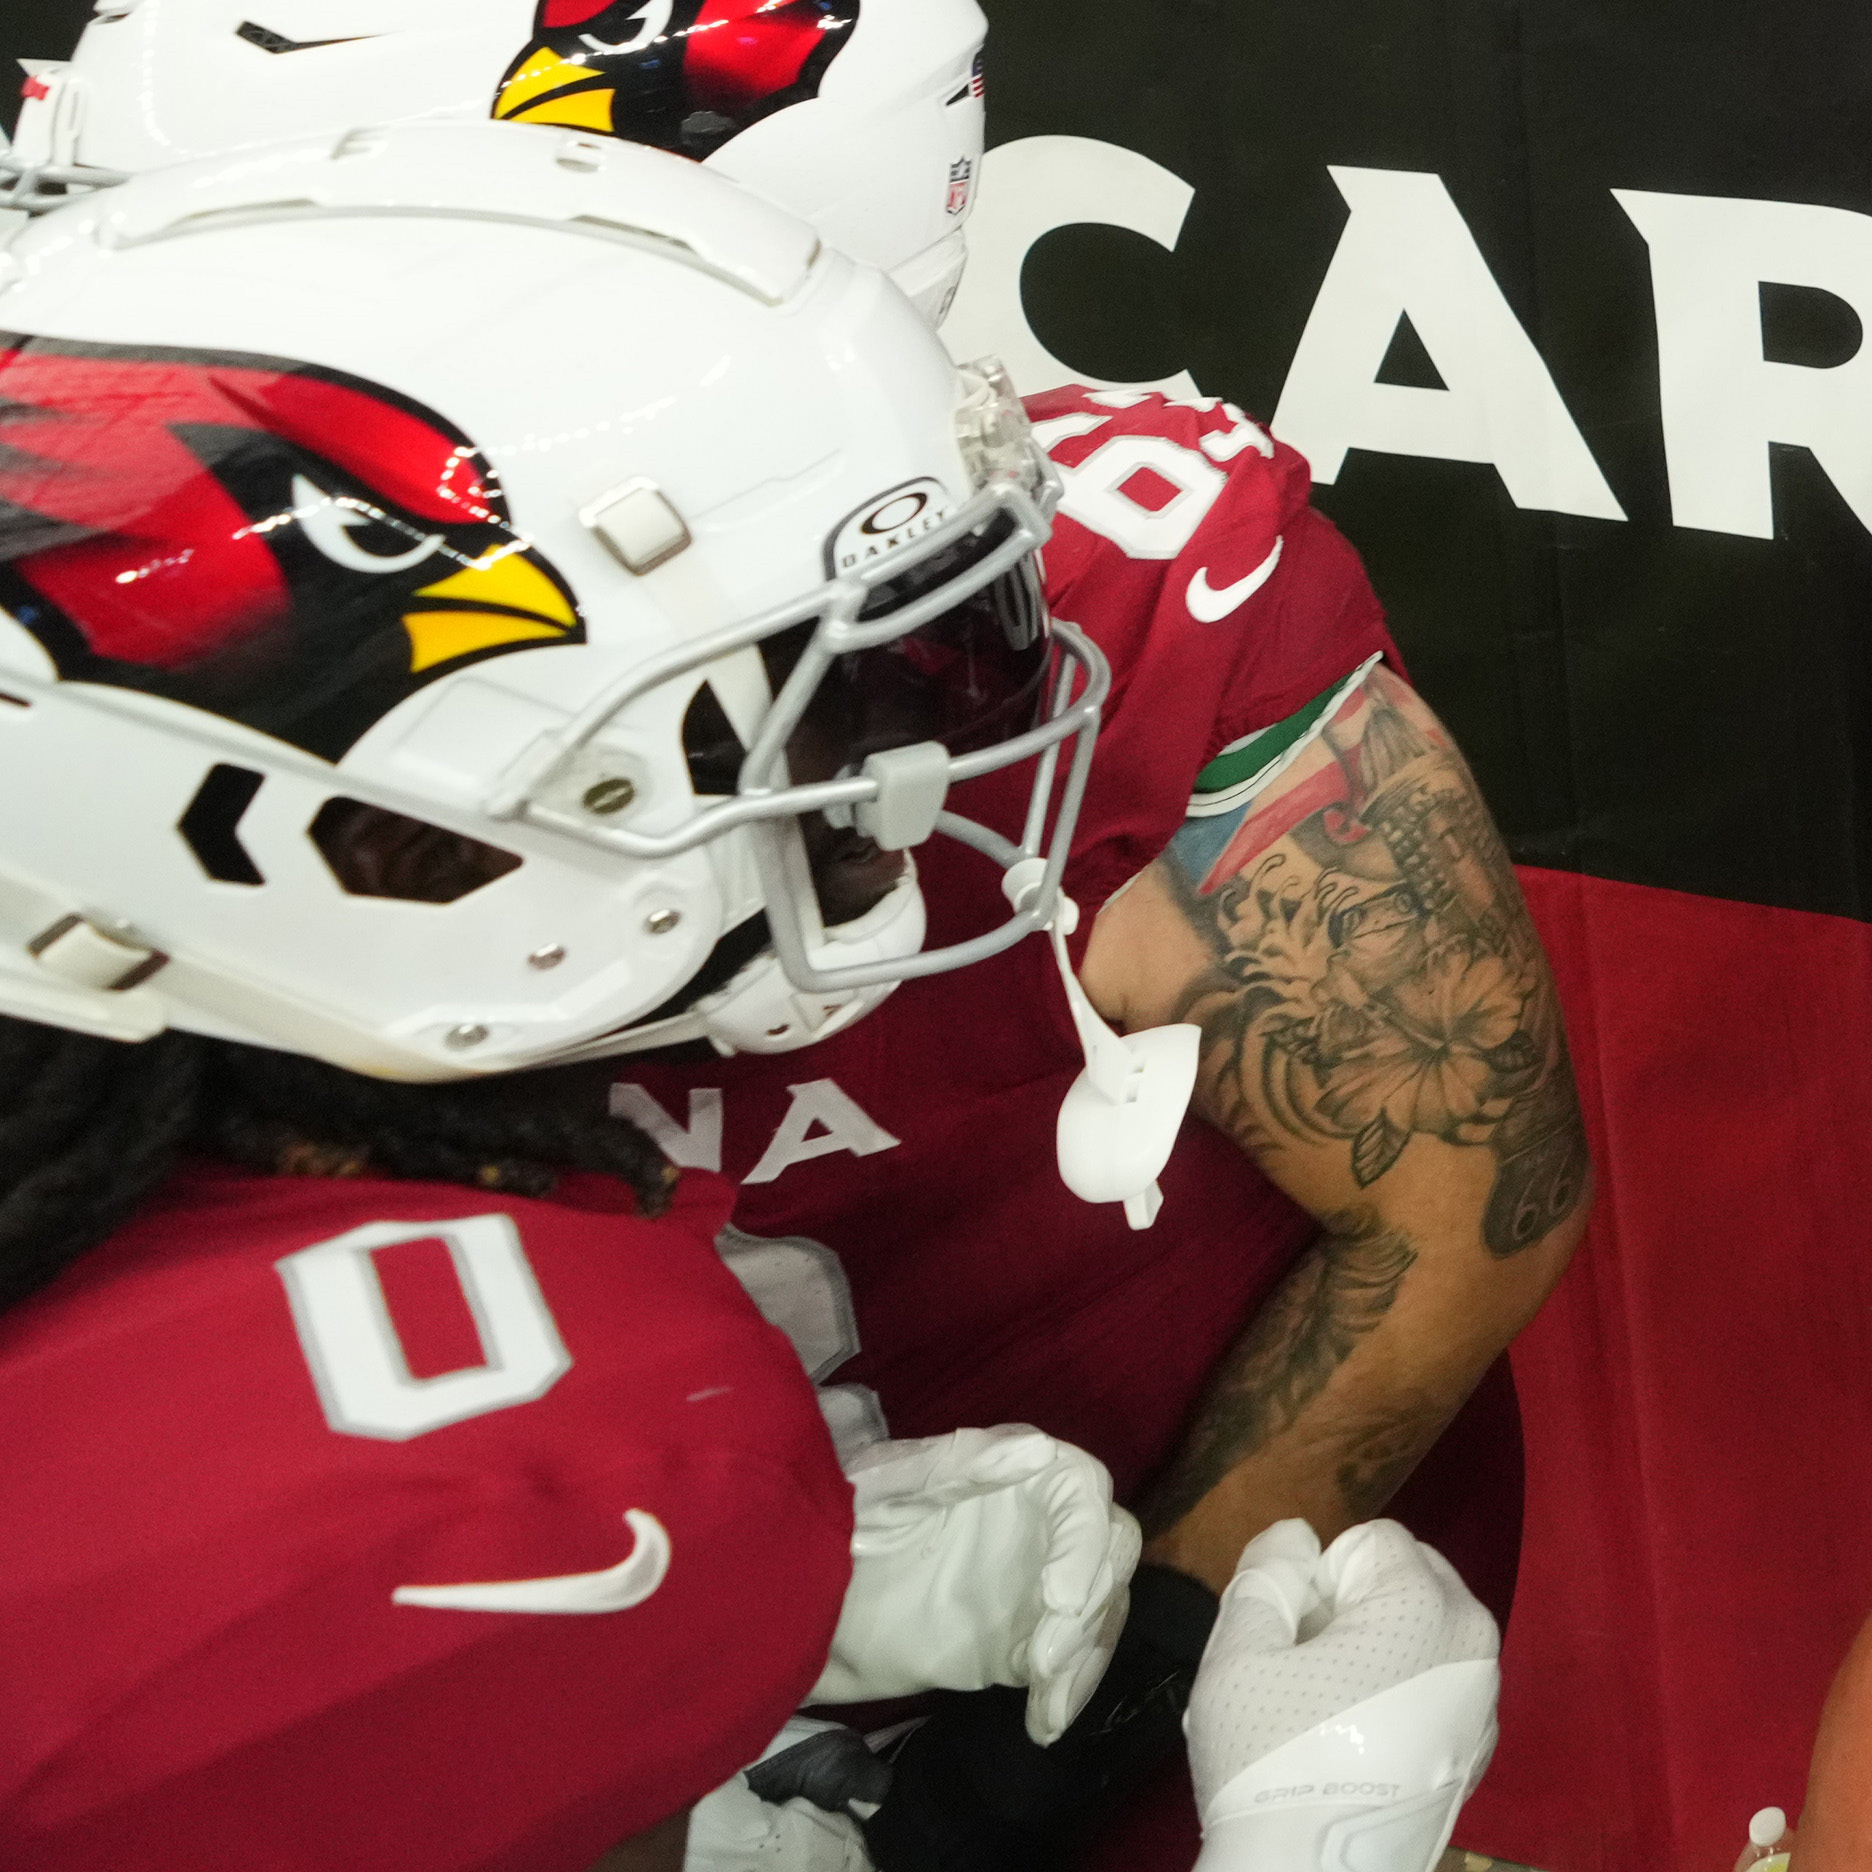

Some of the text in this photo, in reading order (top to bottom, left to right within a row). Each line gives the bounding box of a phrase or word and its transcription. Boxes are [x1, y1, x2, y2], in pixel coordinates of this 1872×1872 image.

[842, 511, 944, 569] OAKLEY
[1253, 1781, 1401, 1804] GRIP BOOST
